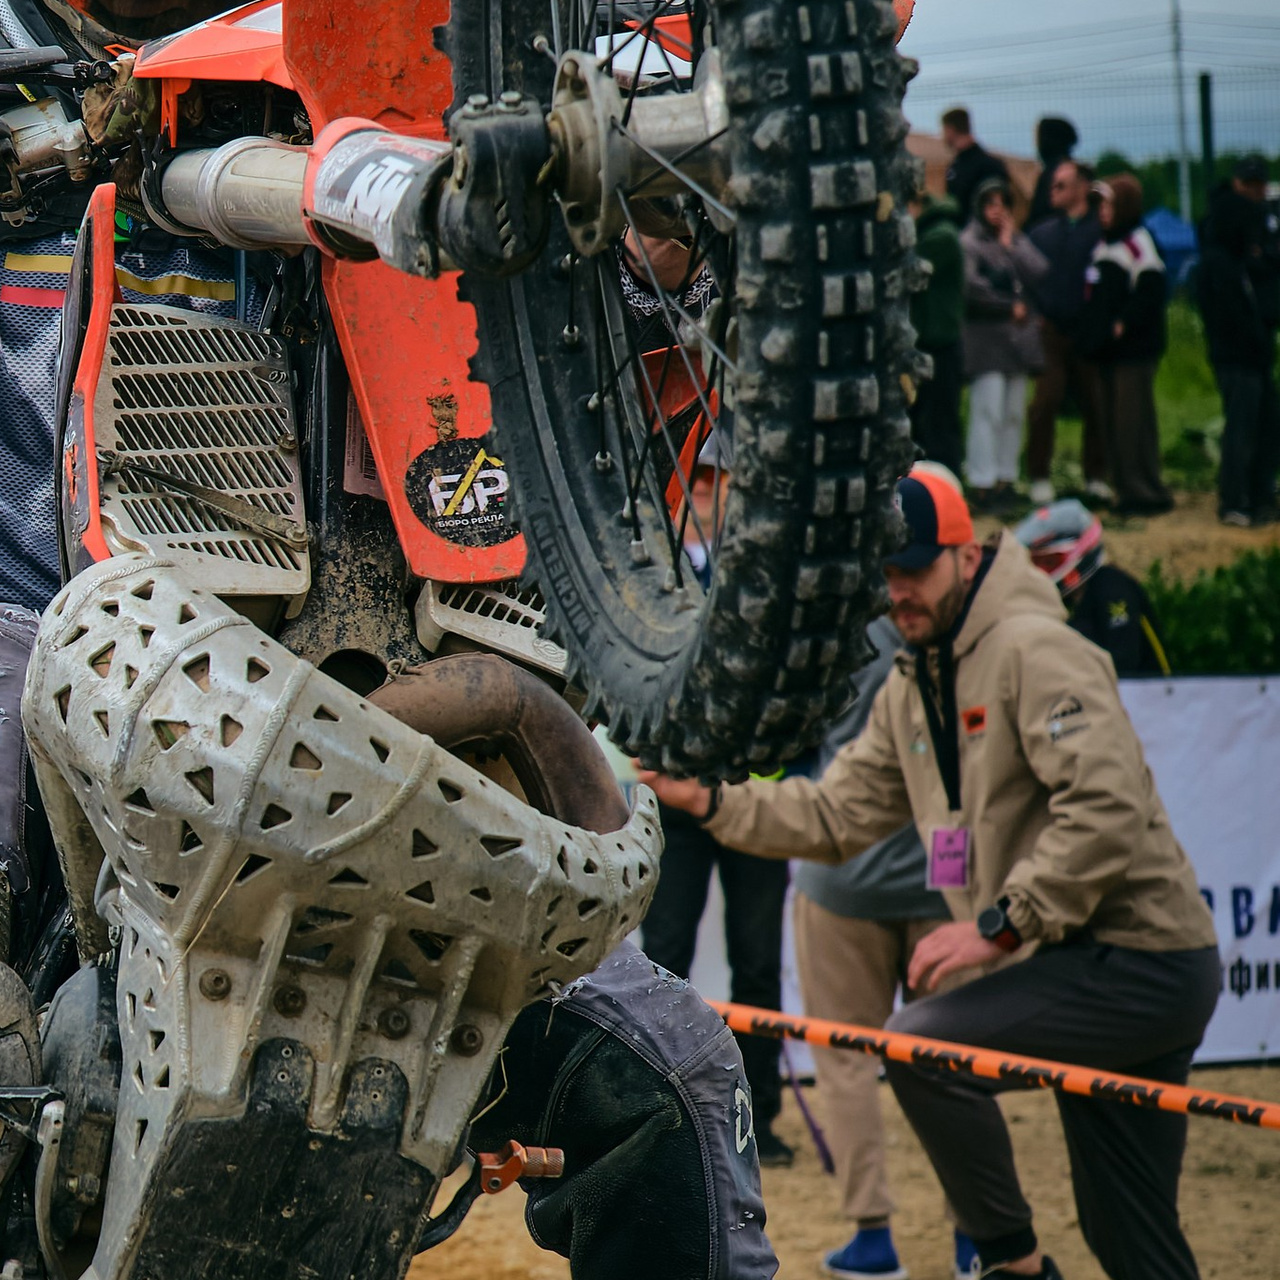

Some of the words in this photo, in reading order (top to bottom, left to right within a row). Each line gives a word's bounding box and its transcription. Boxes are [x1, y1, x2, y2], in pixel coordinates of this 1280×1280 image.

[346, 156, 414, 223] KTM
[438, 519, 469, 528] БЮРО
[532, 517, 593, 637] MICHELIN
